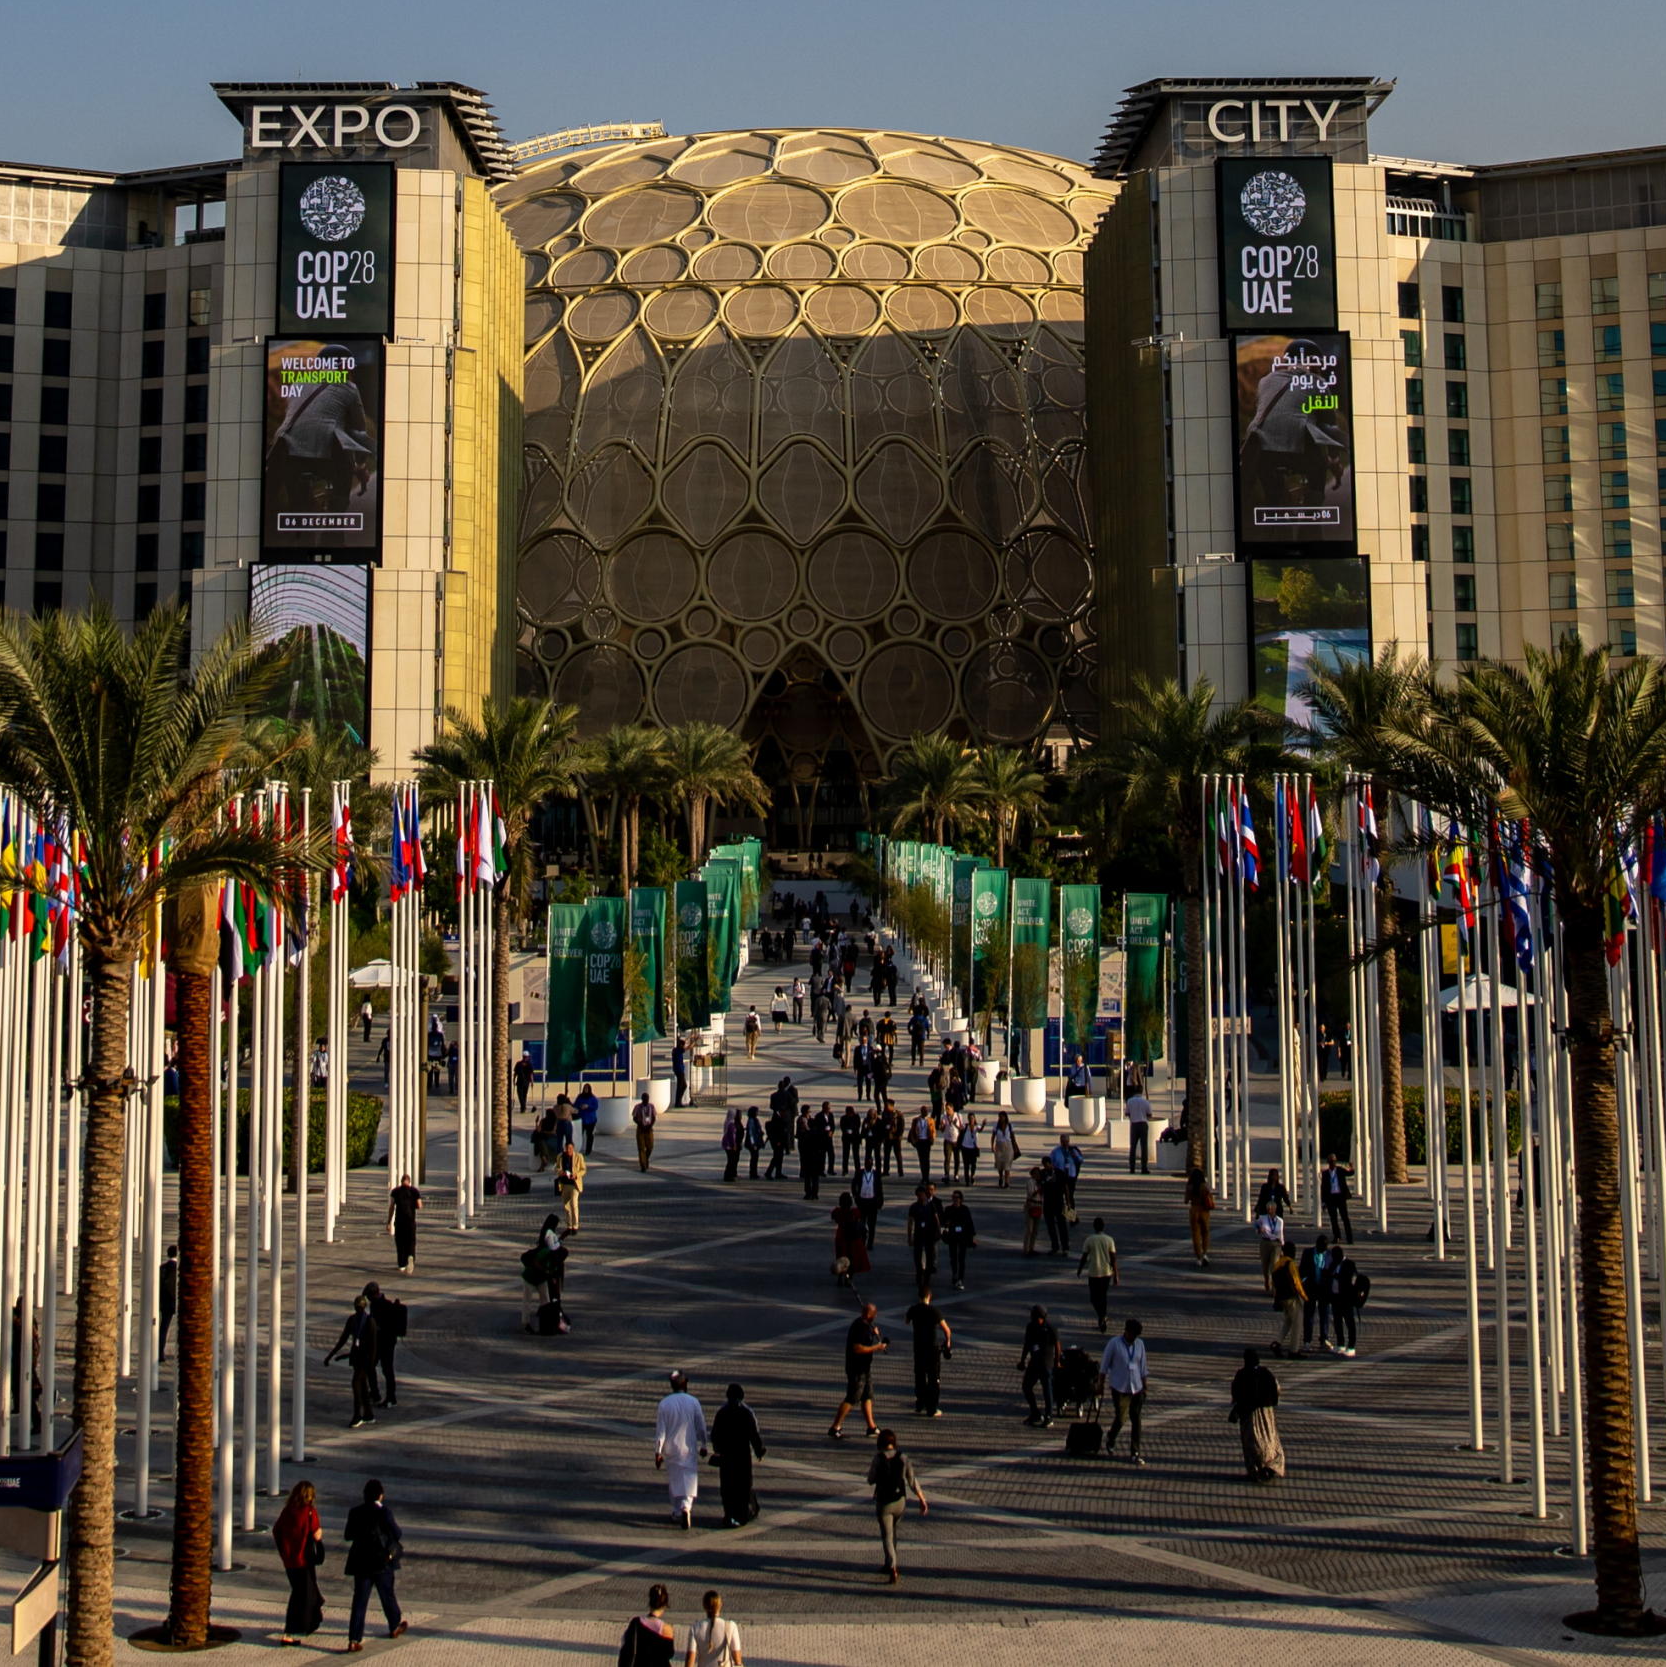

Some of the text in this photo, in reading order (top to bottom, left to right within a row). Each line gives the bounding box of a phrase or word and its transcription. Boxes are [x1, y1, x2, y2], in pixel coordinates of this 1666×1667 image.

[251, 105, 421, 148] EXPO
[1207, 100, 1340, 143] CITY
[297, 250, 375, 284] COP28
[1241, 245, 1319, 279] COP28
[296, 285, 347, 319] UAE
[1242, 280, 1293, 314] UAE
[281, 357, 355, 370] WELCOME TO
[1271, 352, 1298, 373] بكم
[280, 370, 349, 384] TRANSPORT
[1290, 371, 1337, 393] في يوم
[280, 384, 304, 398] DAY
[1301, 395, 1339, 414] النقل
[285, 517, 355, 526] 06 DECEMBER
[1321, 510, 1331, 519] 06
[590, 969, 610, 984] UAE
